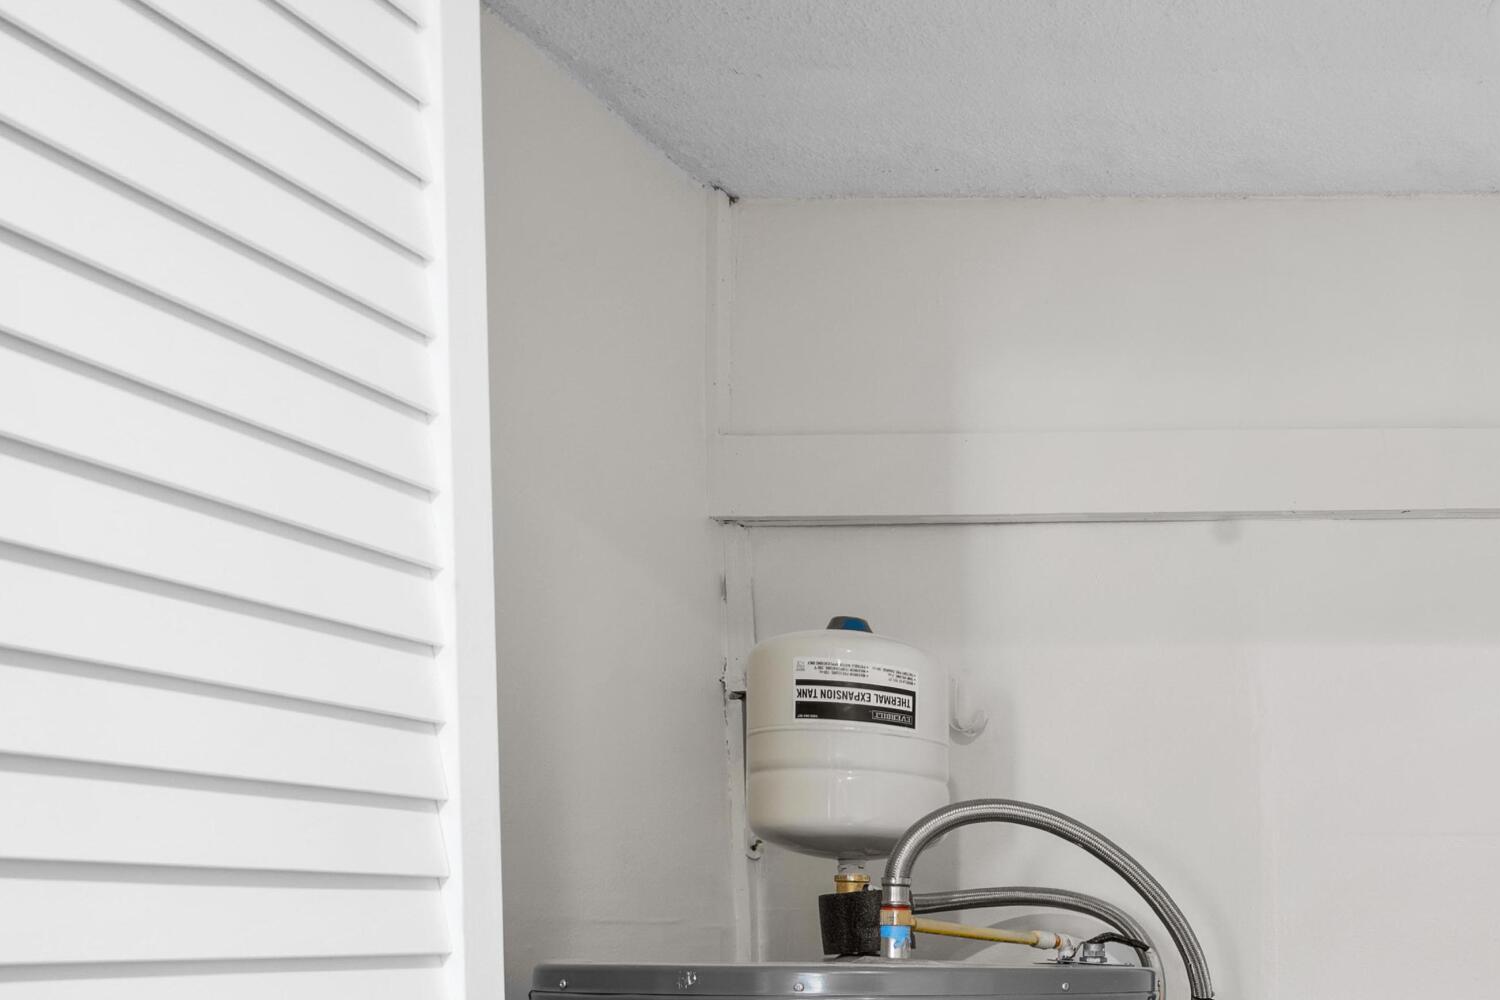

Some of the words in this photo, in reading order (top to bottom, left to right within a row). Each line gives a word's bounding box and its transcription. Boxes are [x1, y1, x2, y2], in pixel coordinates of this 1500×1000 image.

[796, 688, 818, 699] TANK
[820, 689, 872, 703] EXPANSION
[873, 693, 911, 709] THERMAL
